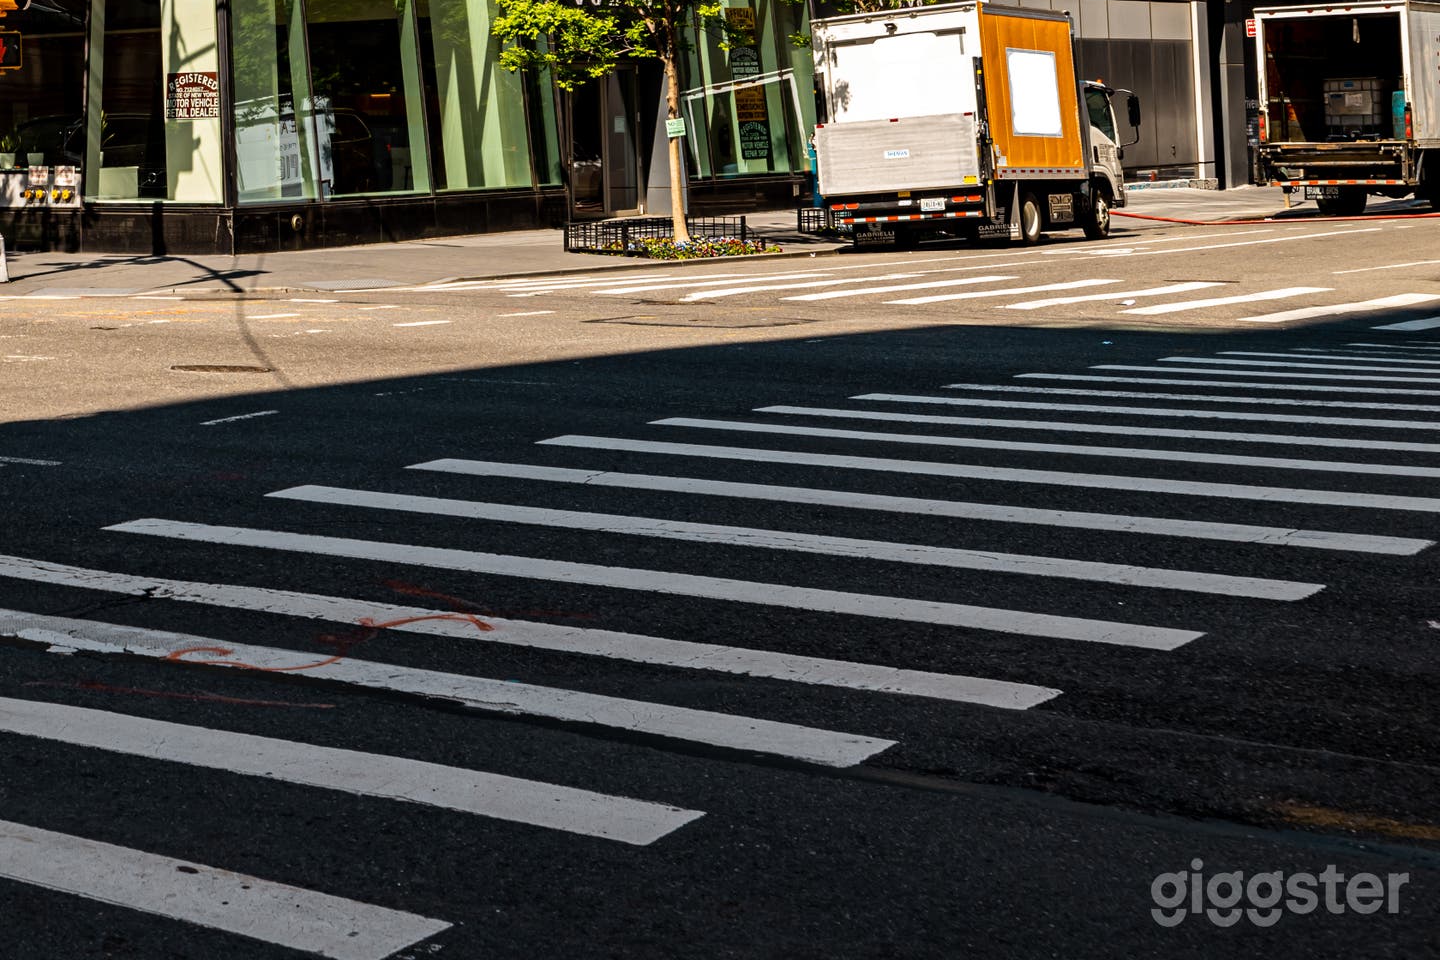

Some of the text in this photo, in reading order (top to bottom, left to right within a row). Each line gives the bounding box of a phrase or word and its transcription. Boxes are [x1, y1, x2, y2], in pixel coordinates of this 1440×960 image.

[168, 73, 218, 91] REGISTERED
[167, 98, 219, 108] MOTOR VEHICLE
[167, 108, 219, 117] RETAIL DEALER
[856, 230, 895, 238] GABRIELLI
